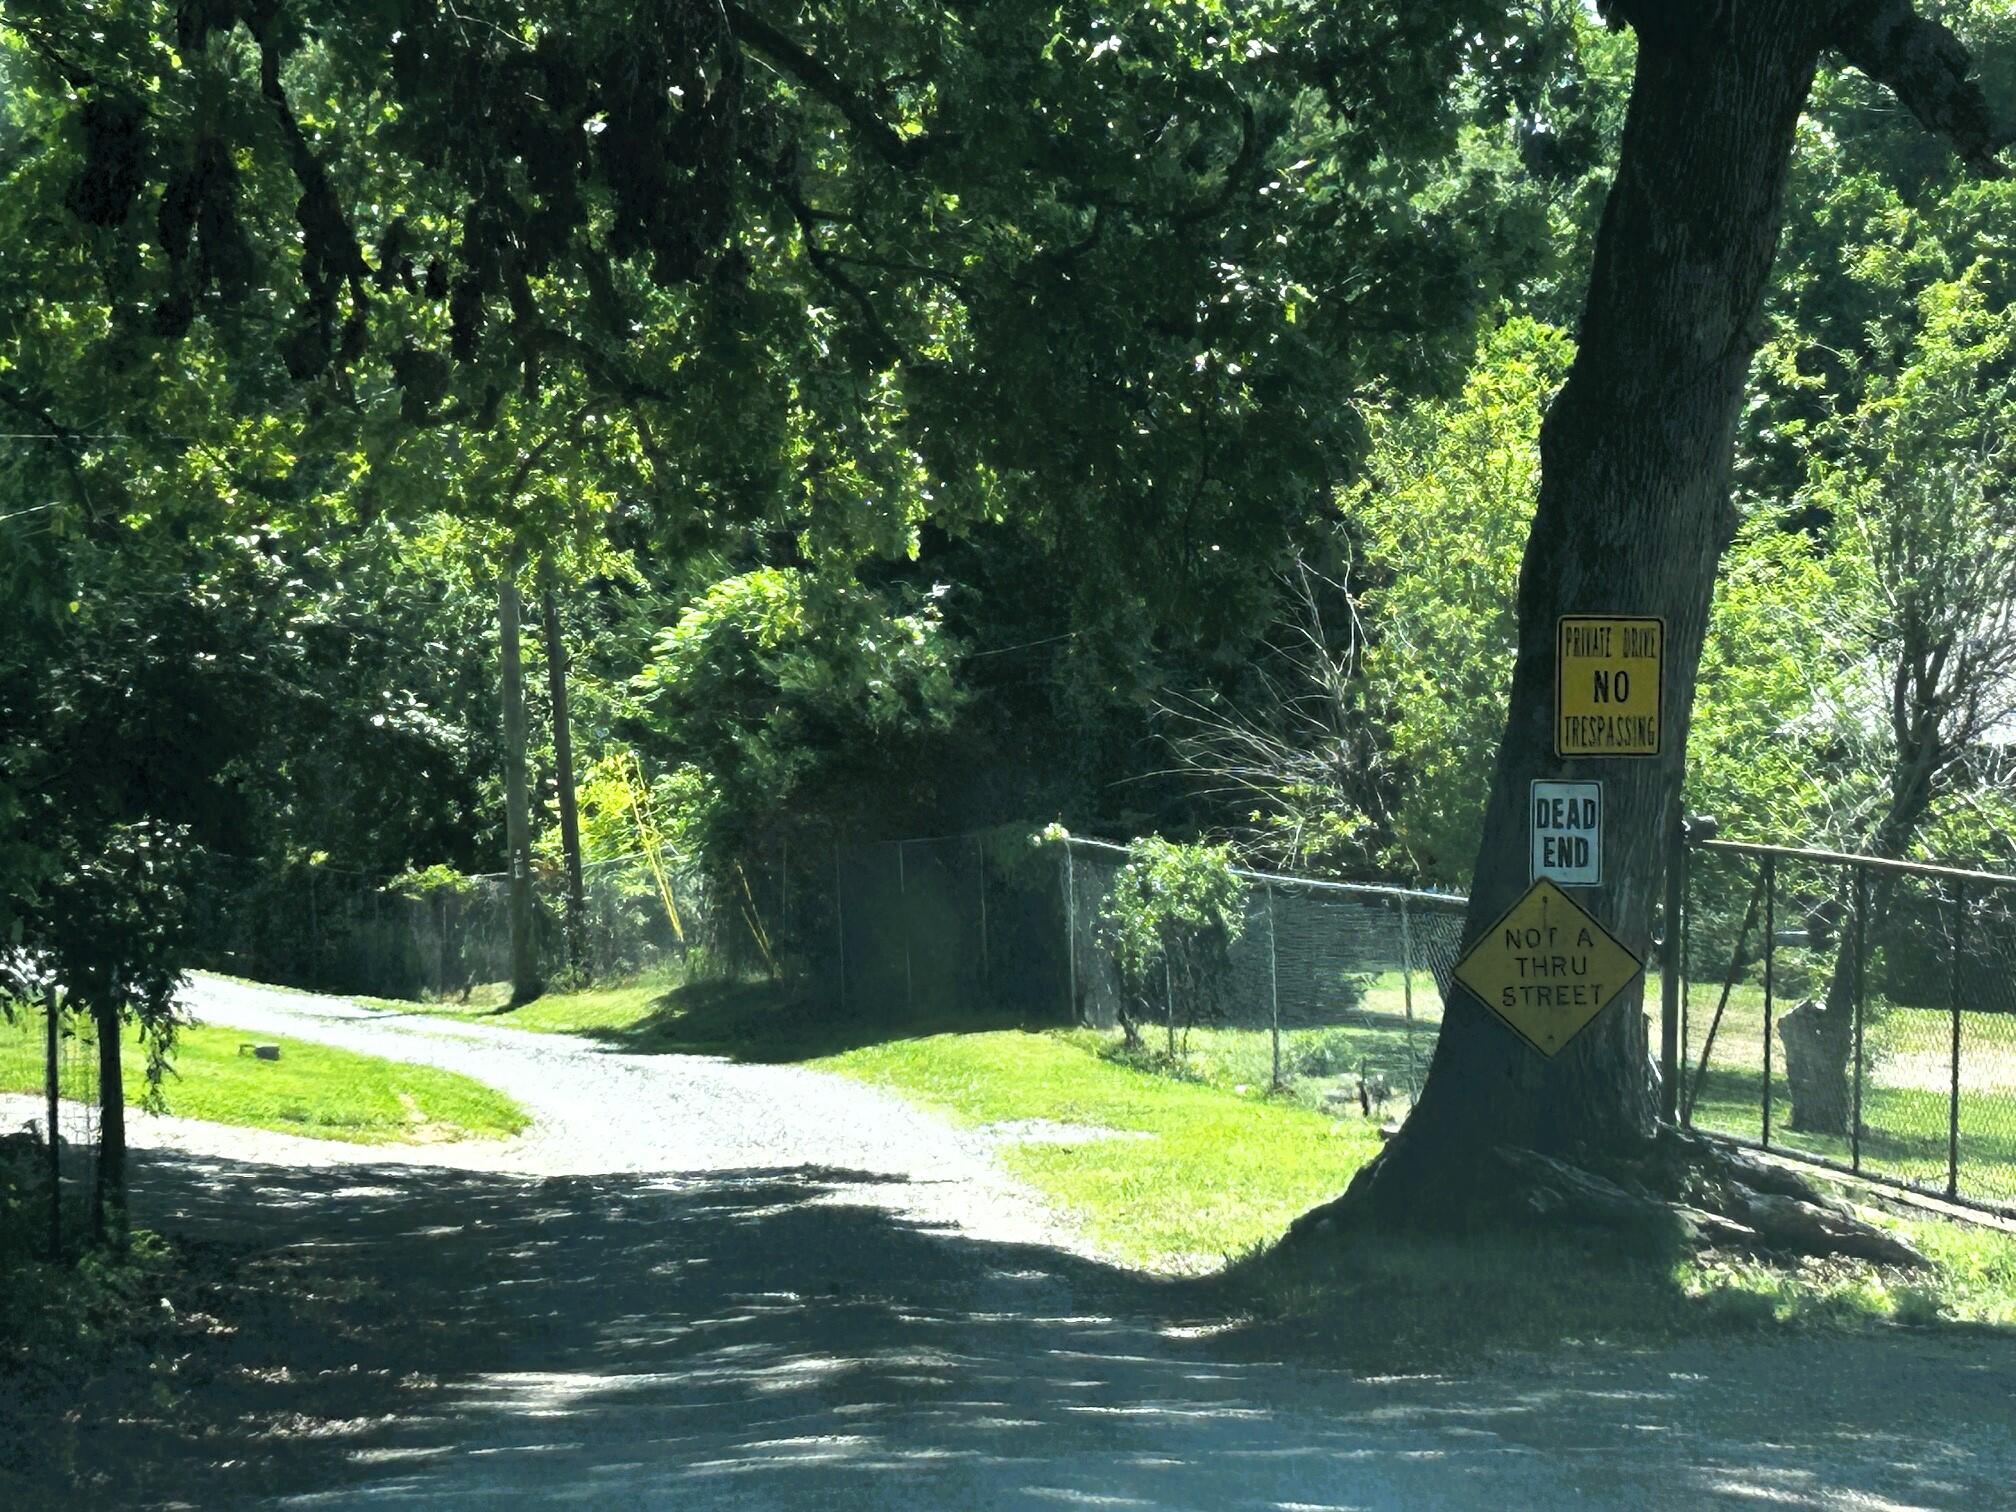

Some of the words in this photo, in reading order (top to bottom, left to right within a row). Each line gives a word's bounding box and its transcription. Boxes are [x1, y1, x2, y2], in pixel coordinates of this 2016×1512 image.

[1593, 670, 1629, 703] NO
[1565, 715, 1655, 747] TRESPASSING
[1536, 798, 1596, 830] DEAD
[1543, 836, 1589, 868] END
[1506, 928, 1558, 949] NOT
[1576, 928, 1594, 947] A
[1514, 956, 1587, 977] THRU
[1502, 984, 1603, 1007] STREET
